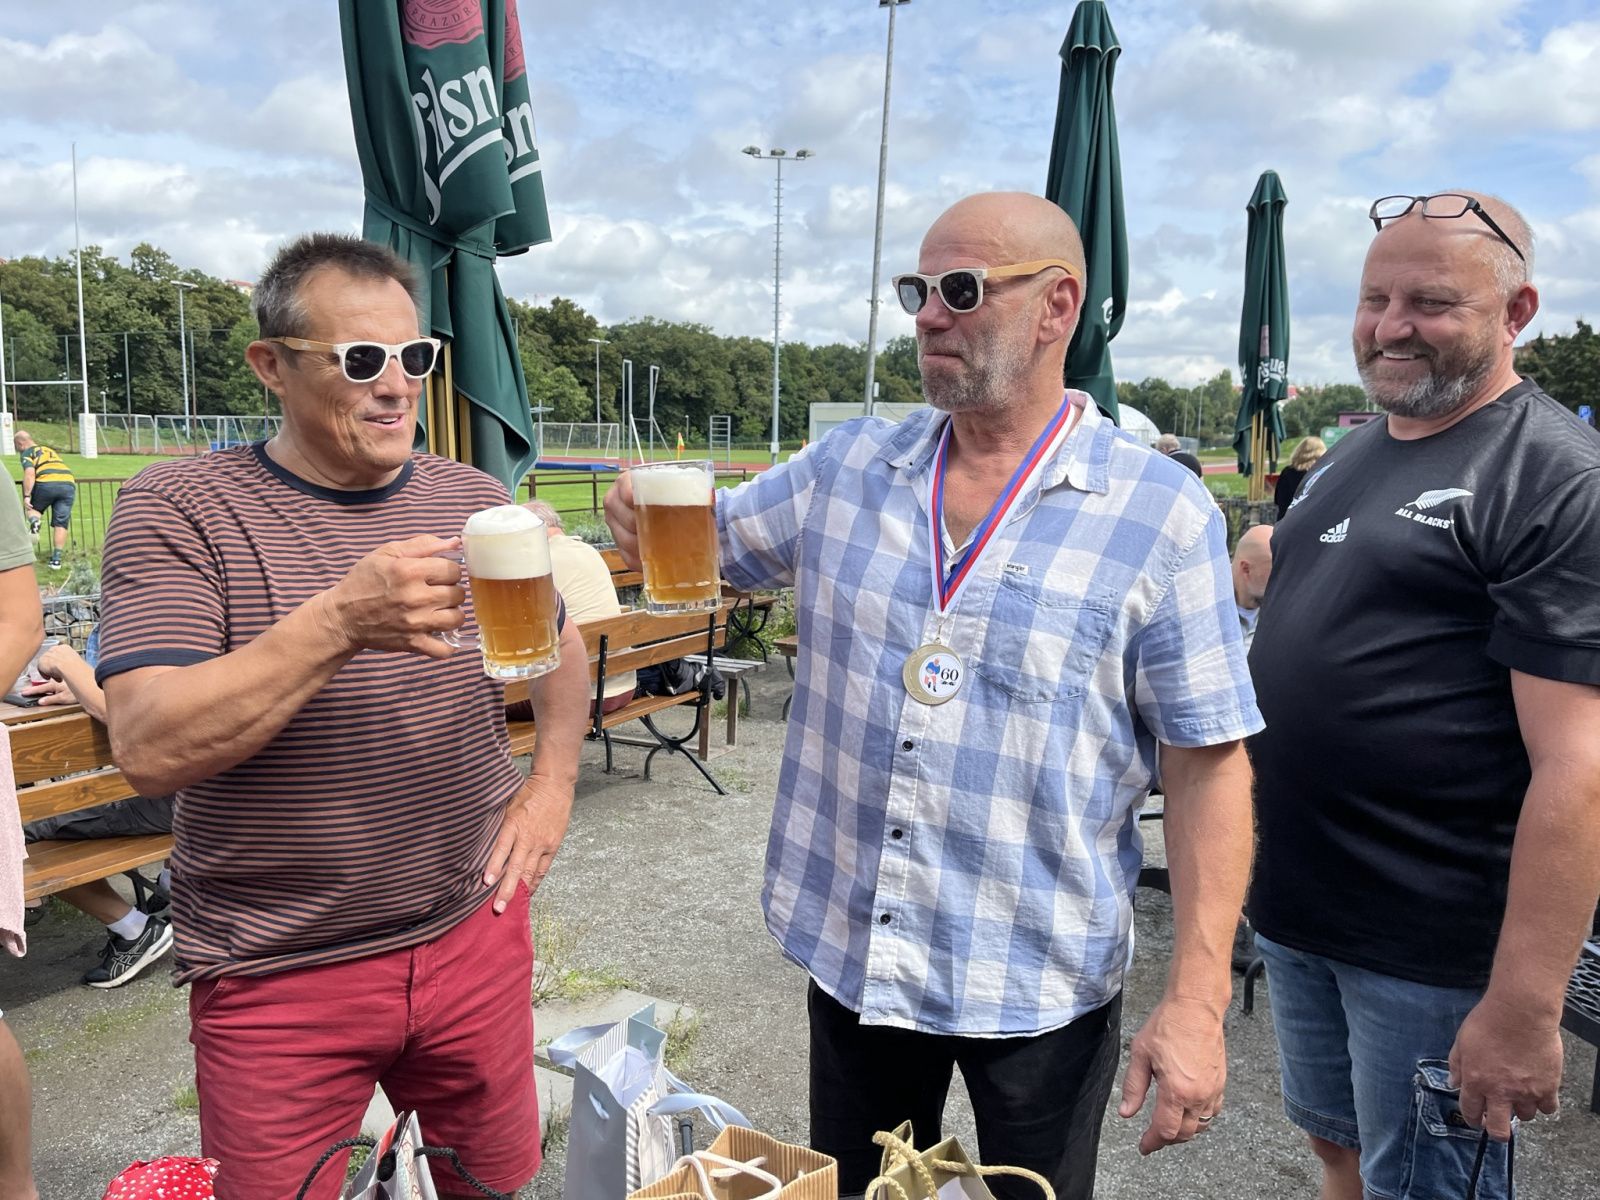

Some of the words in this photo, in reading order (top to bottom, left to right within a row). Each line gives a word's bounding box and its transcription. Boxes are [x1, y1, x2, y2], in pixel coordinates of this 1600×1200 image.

[1394, 508, 1413, 519] ALL
[1412, 513, 1450, 529] BLACKS
[940, 668, 959, 682] 60
